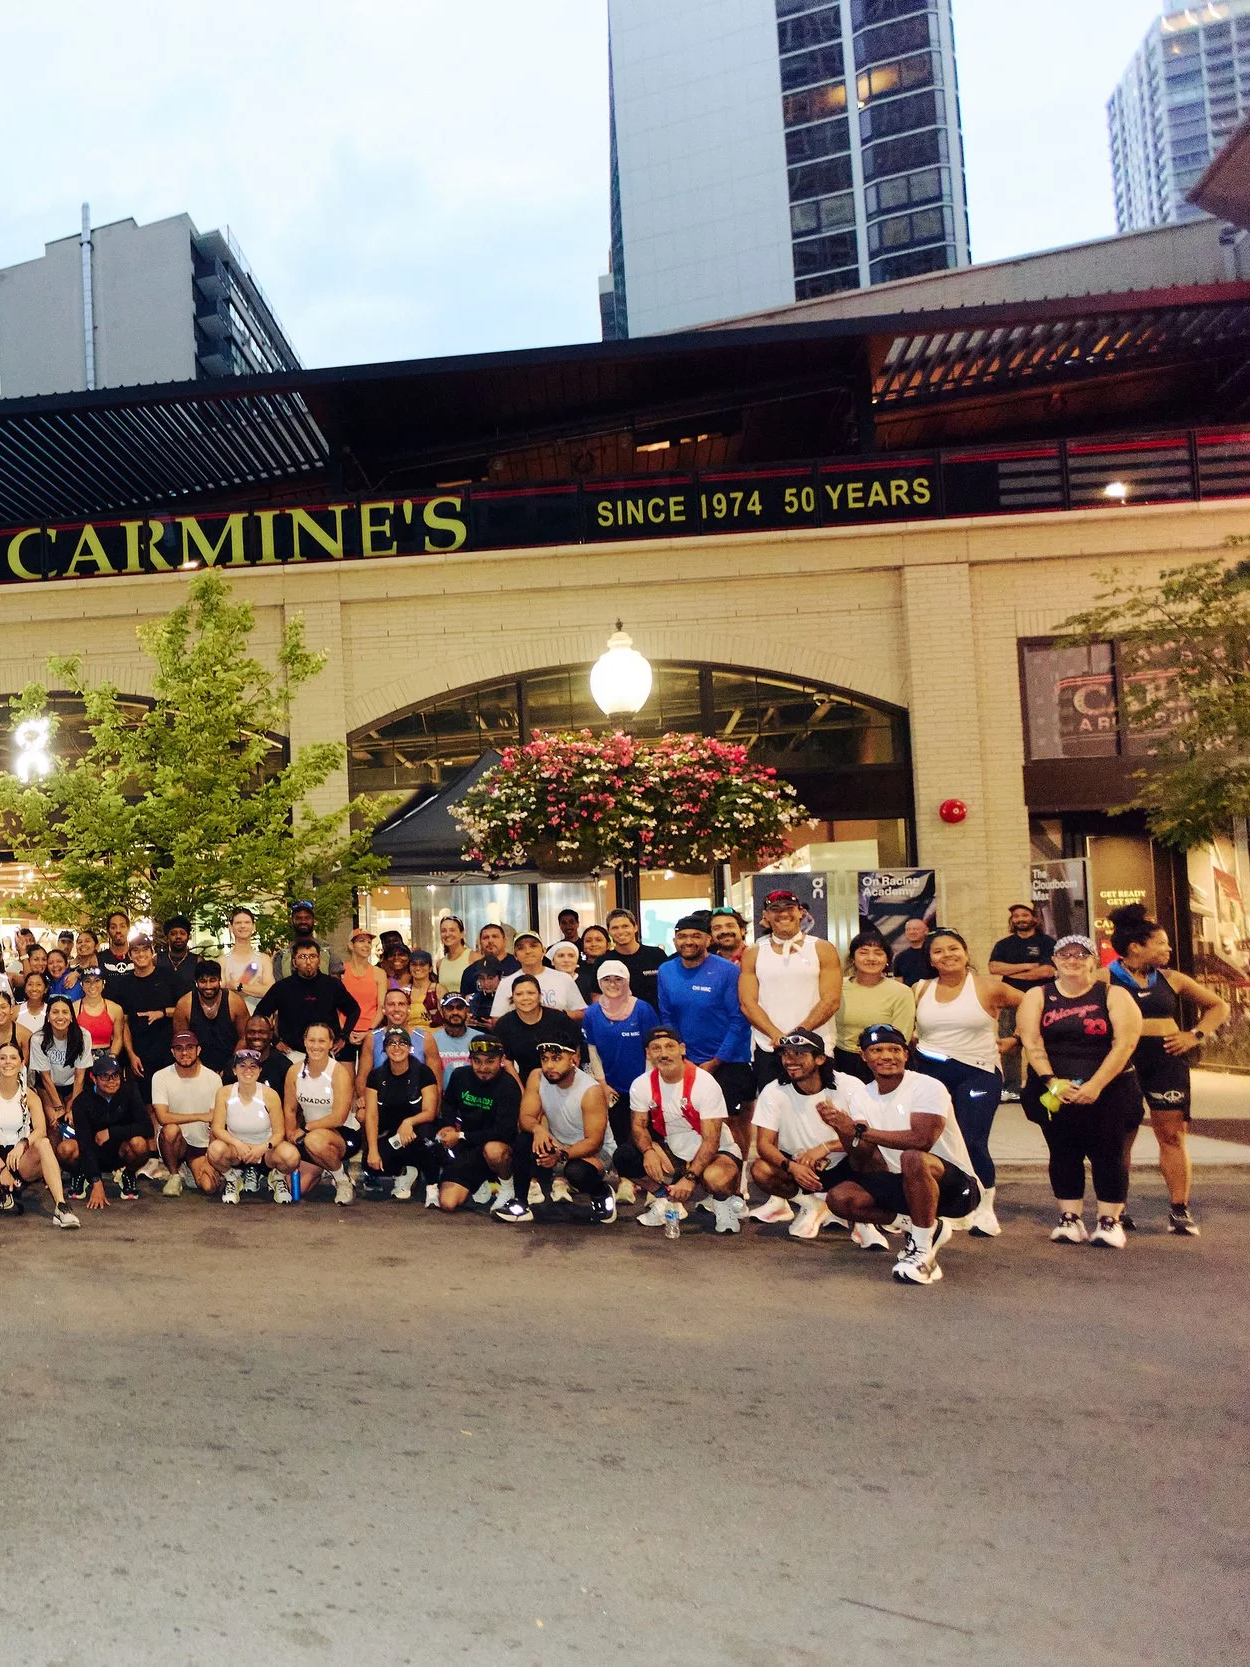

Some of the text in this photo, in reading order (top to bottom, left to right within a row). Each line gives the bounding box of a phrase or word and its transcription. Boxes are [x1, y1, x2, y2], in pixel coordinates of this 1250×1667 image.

[597, 477, 931, 527] SINCE 1974 50 YEARS
[7, 497, 467, 580] CARMINE'S
[1033, 869, 1047, 879] The
[862, 876, 920, 887] On Racing
[863, 887, 916, 898] Academy
[1100, 890, 1146, 899] GET READY
